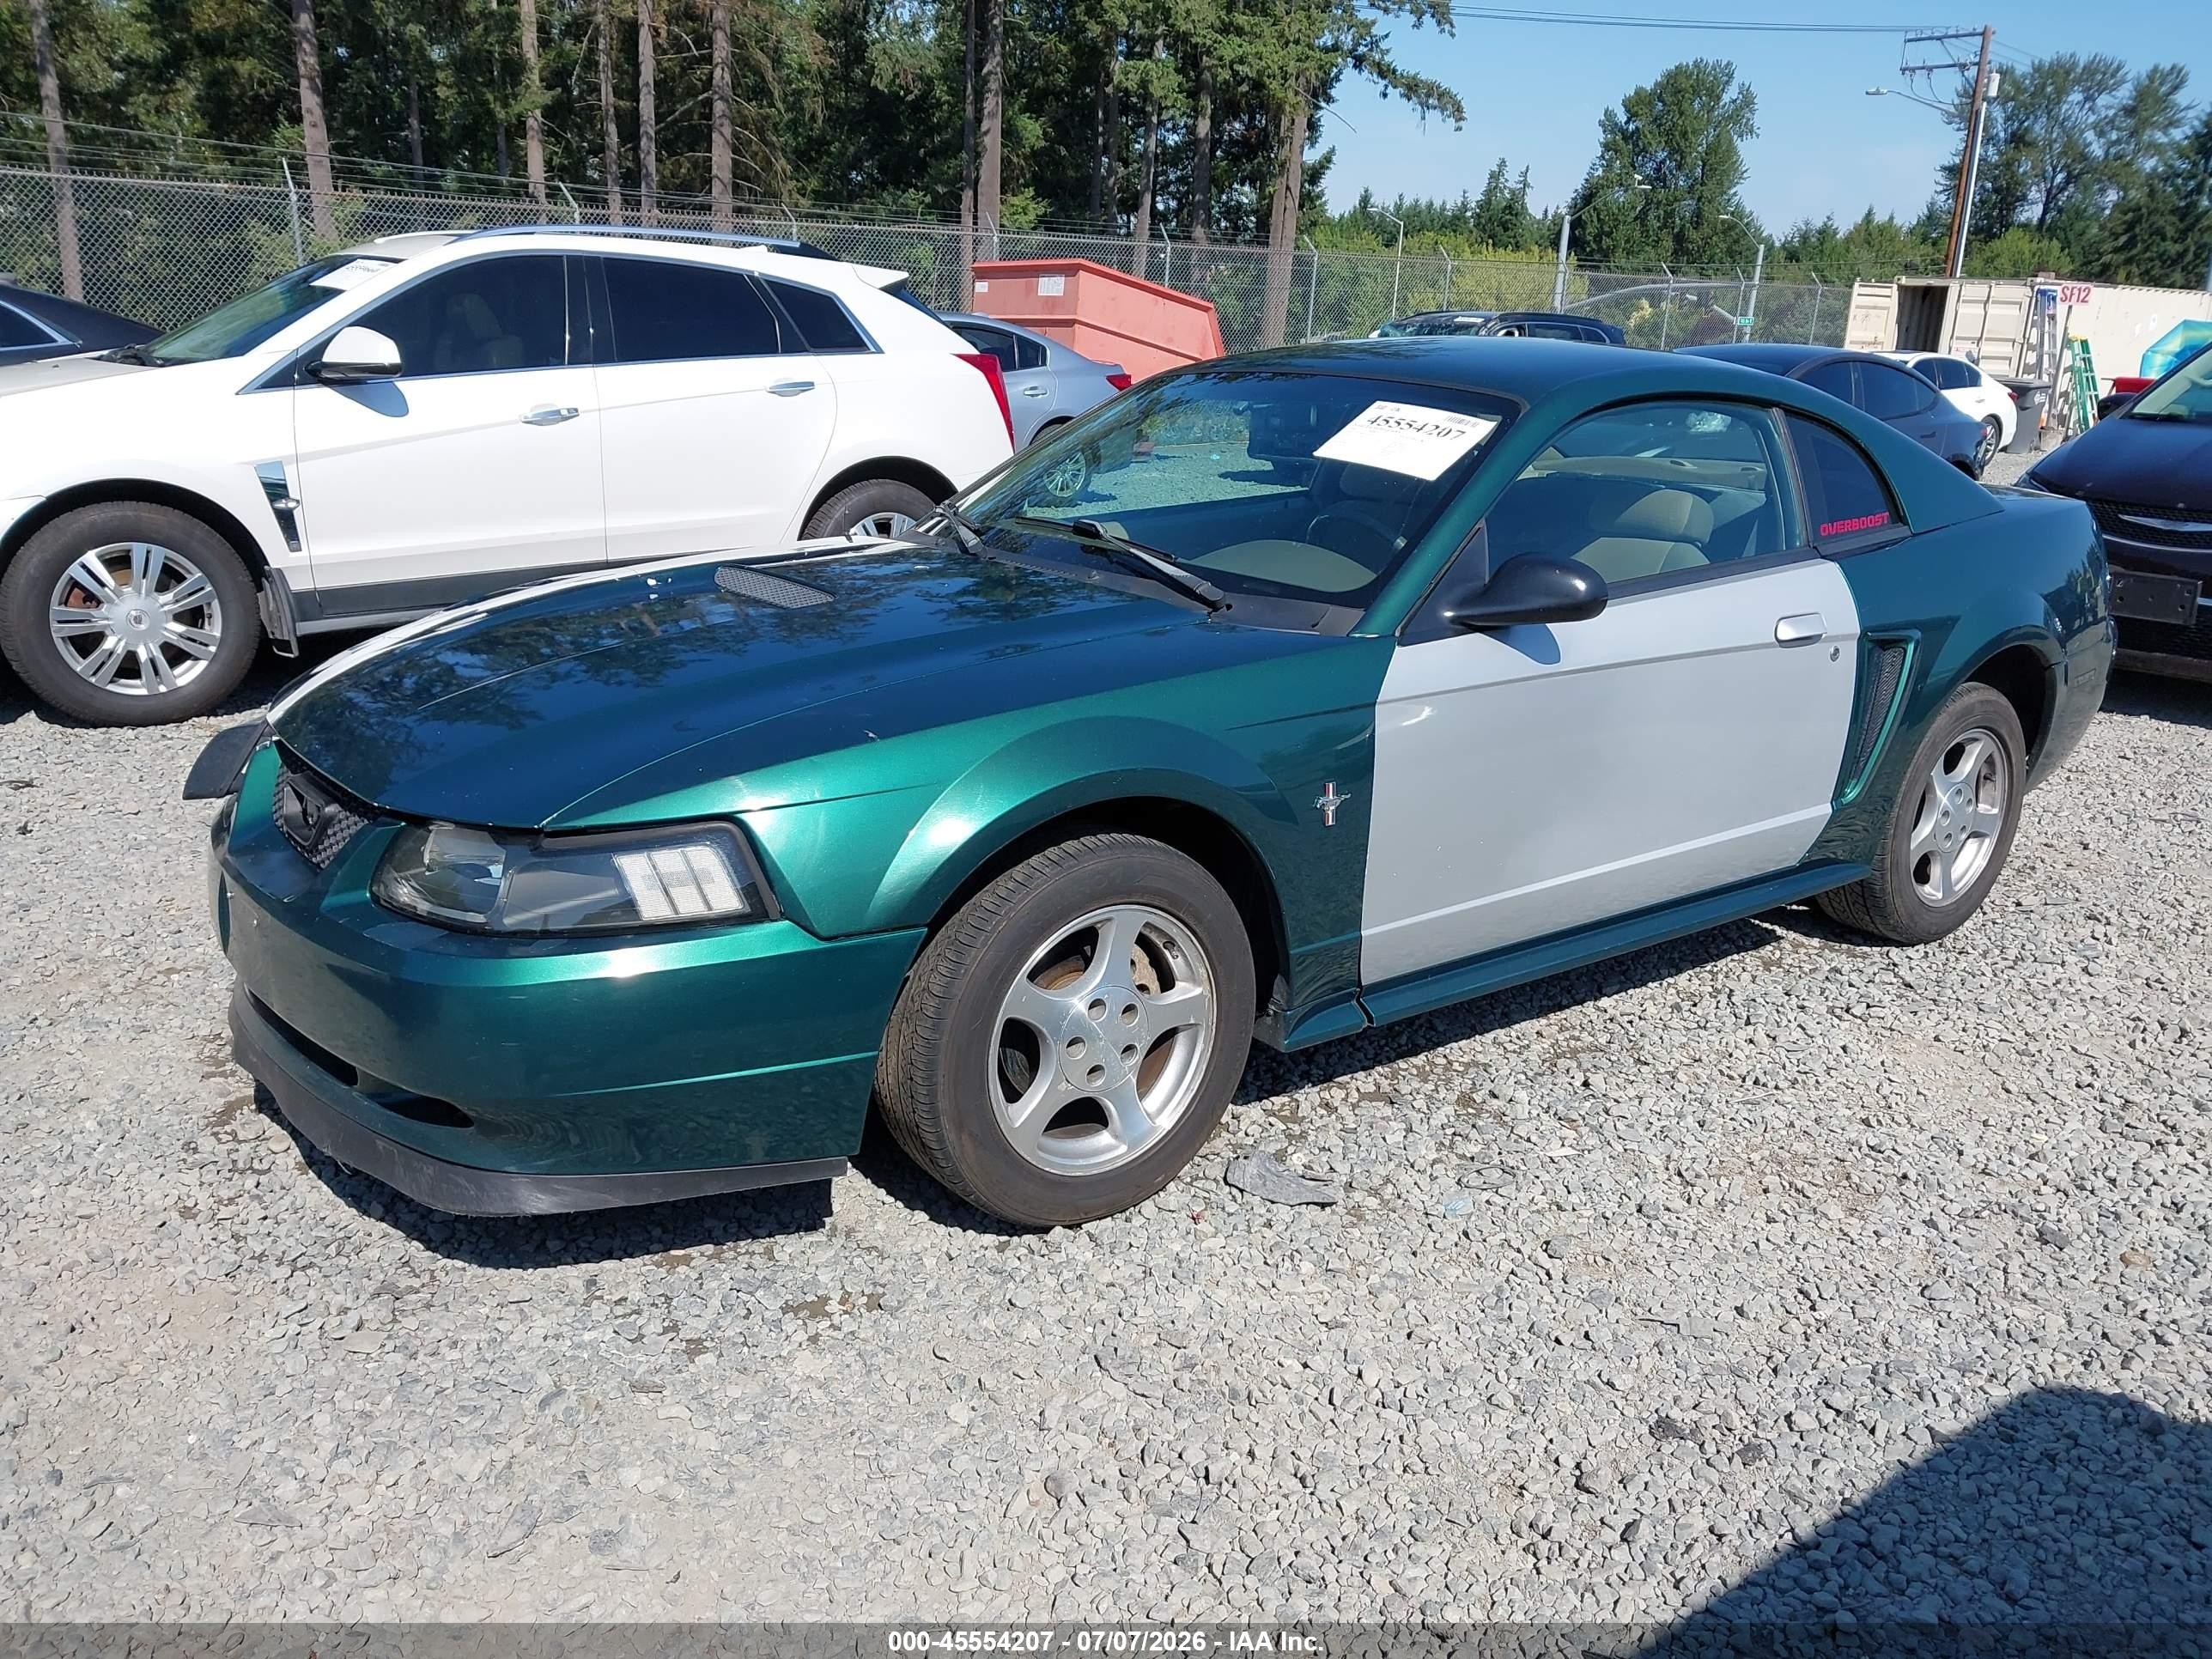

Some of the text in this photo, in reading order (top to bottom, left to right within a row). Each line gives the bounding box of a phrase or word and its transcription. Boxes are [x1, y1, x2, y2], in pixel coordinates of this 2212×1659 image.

[2060, 285, 2092, 303] SF12
[1366, 414, 1467, 441] 45554207
[1820, 511, 1890, 536] OVERBOOST
